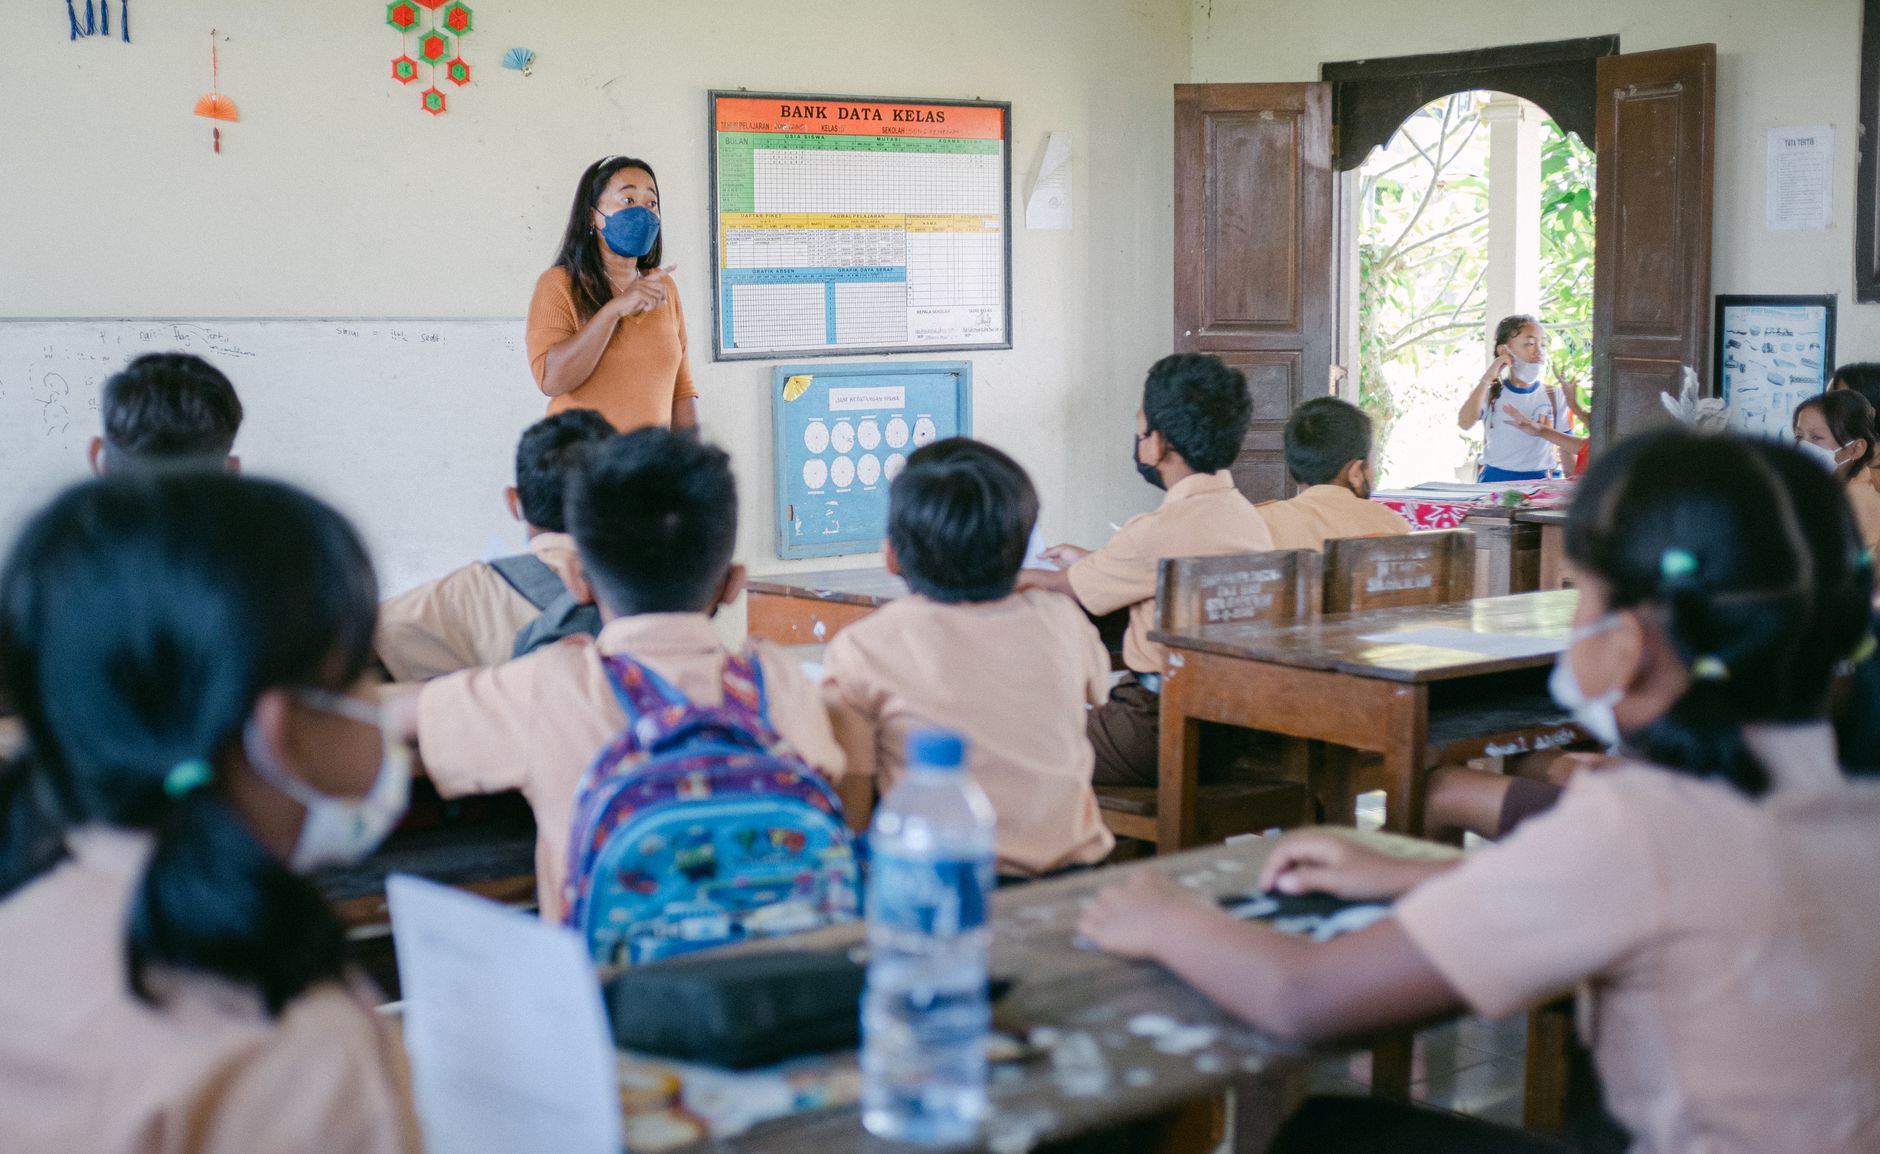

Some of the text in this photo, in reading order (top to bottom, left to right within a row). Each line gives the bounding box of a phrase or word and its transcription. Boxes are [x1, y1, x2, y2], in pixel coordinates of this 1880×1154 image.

[781, 105, 945, 123] BANK DATA KELAS
[739, 122, 769, 130] PELAJARAN
[725, 137, 748, 145] BULAN
